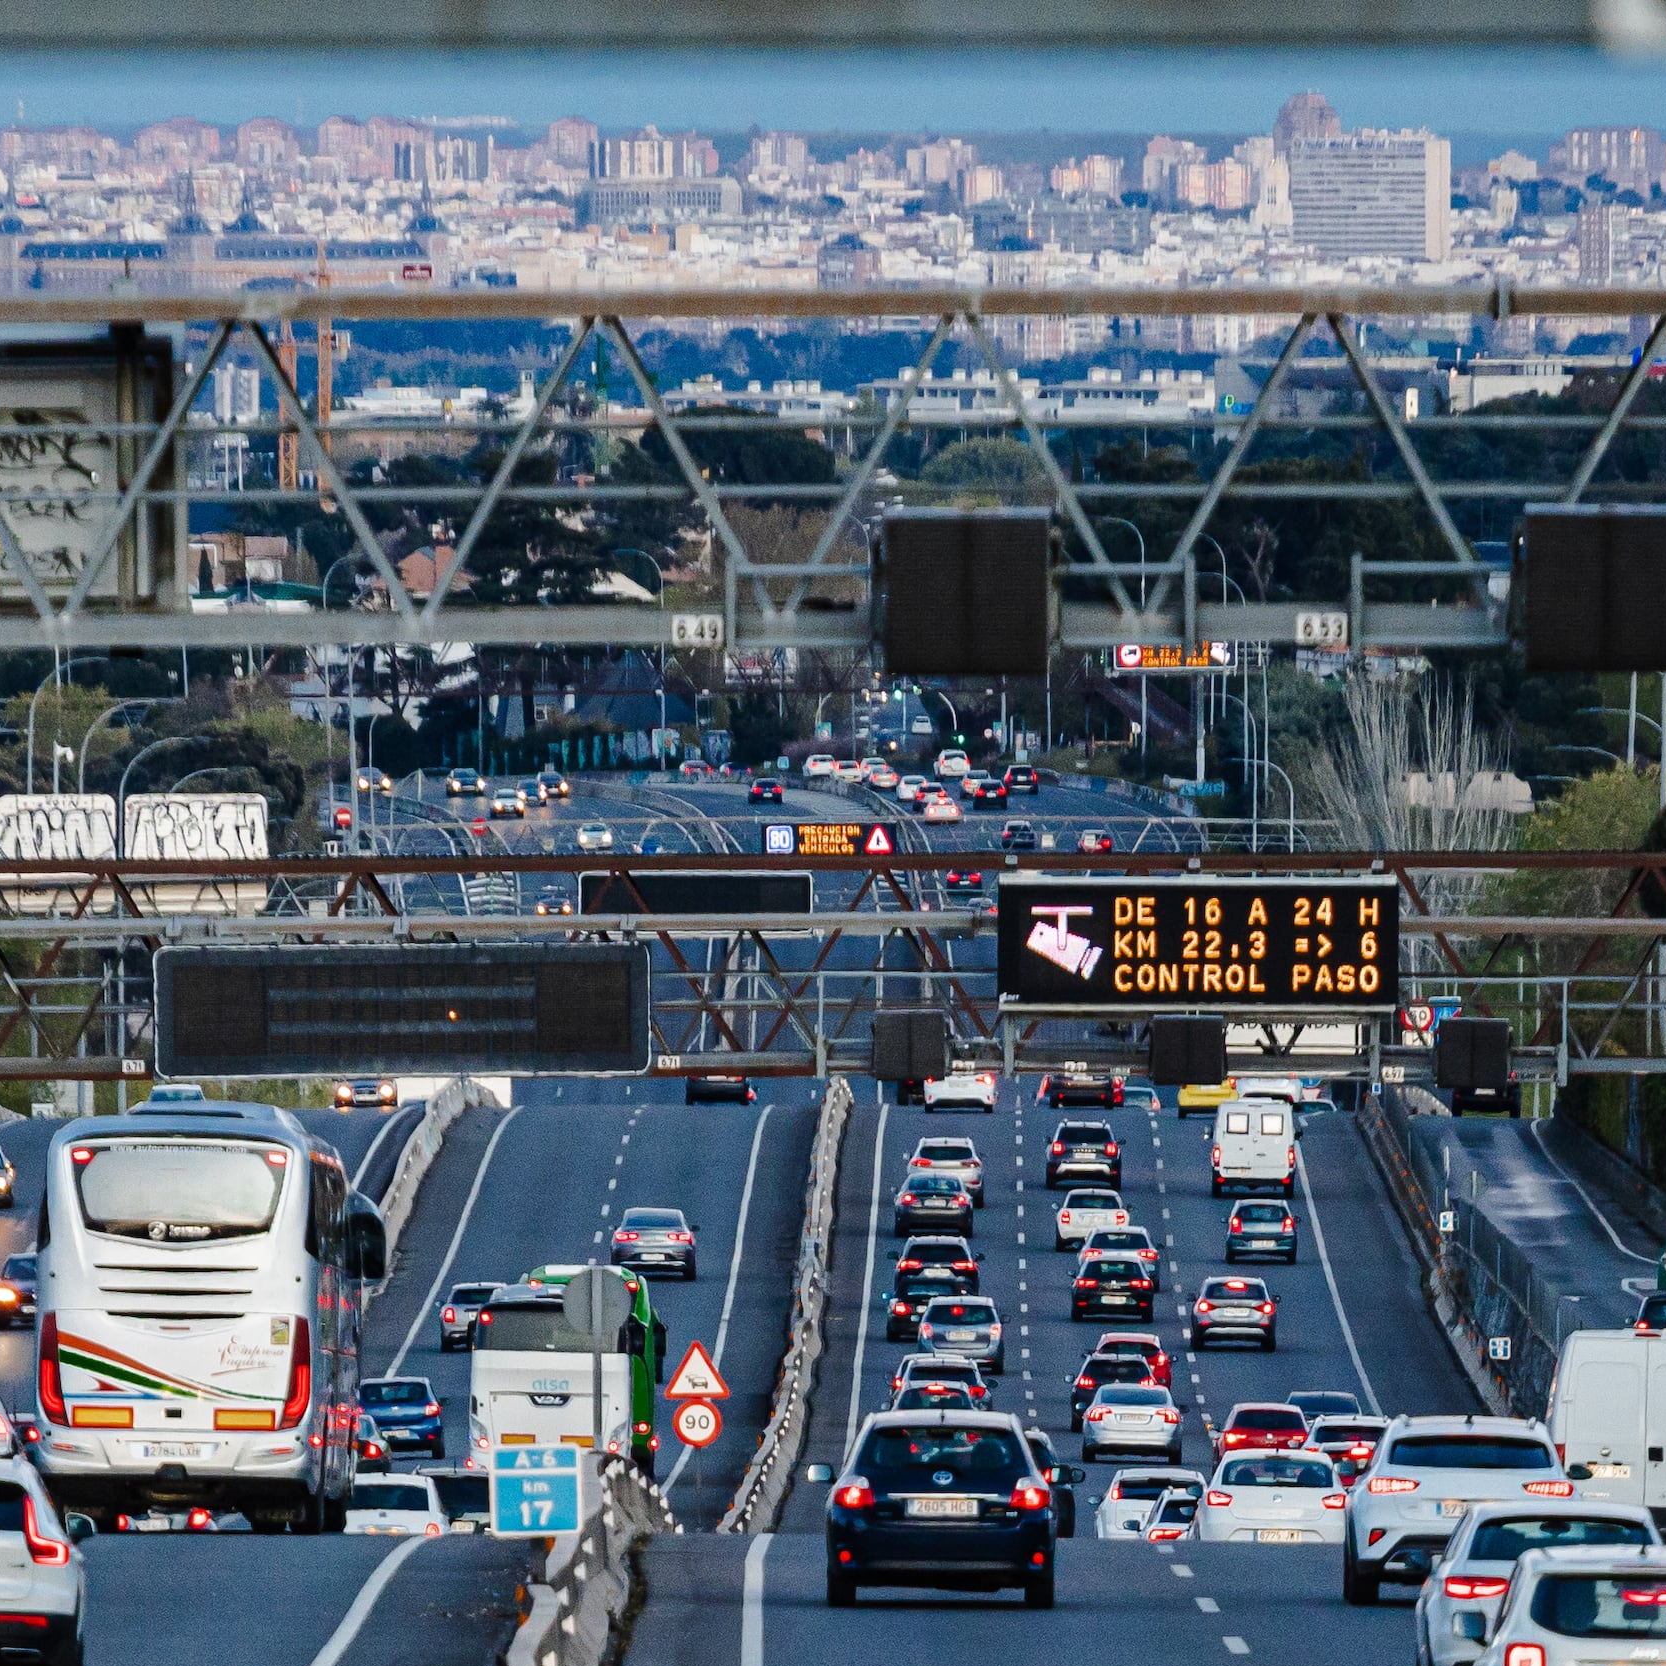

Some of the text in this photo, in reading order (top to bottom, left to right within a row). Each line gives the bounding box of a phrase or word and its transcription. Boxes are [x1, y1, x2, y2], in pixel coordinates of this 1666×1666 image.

[798, 825, 861, 835] PRECAUCION
[770, 830, 790, 848] 80
[804, 834, 848, 844] ENTRADA
[798, 843, 855, 855] VEHICULOS
[1115, 897, 1380, 926] DE 16 A 24 H
[1115, 931, 1157, 958] KM
[1360, 931, 1378, 959] 6
[1115, 964, 1380, 992] CONTROL PASO
[532, 1377, 570, 1391] alsa
[684, 1414, 711, 1430] 90
[514, 1450, 558, 1469] A-6
[522, 1480, 550, 1494] km
[520, 1500, 554, 1528] 17
[916, 1500, 947, 1512] 2605
